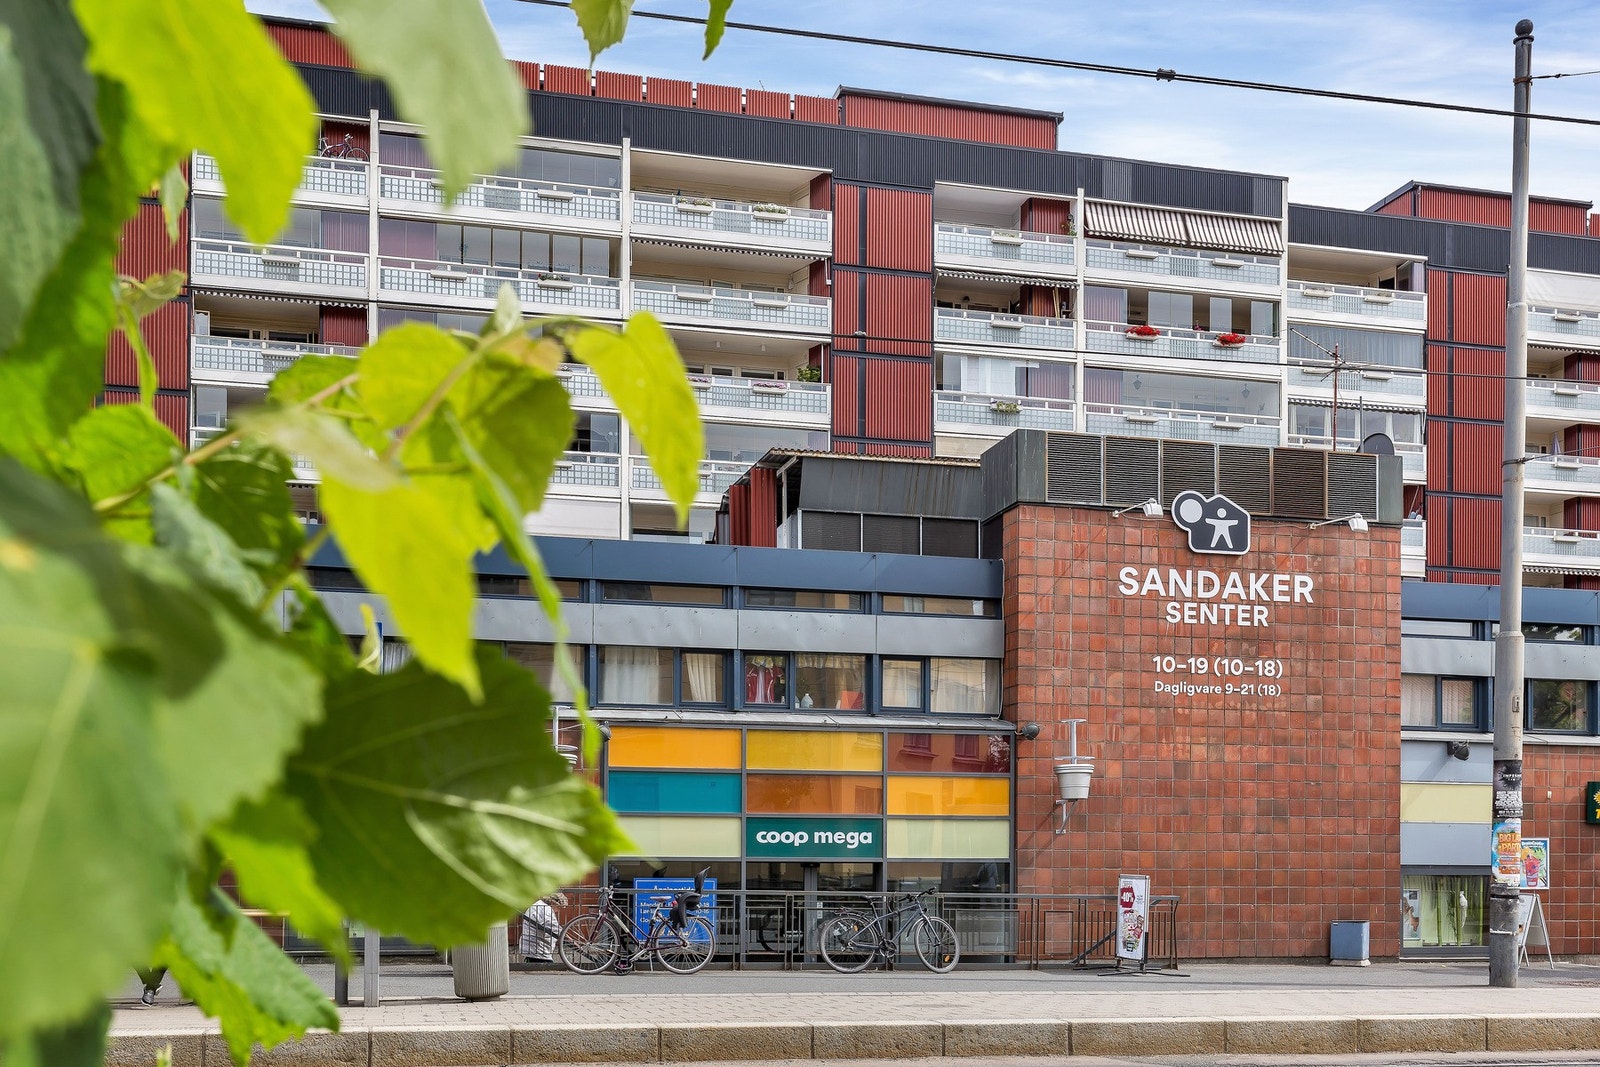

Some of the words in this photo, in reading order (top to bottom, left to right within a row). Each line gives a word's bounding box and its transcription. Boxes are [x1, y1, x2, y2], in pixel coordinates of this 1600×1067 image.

[1118, 566, 1314, 604] SANDAKER
[1165, 601, 1269, 627] SENTER
[1154, 680, 1222, 696] Dagligvare
[1257, 683, 1282, 697] (18)
[756, 830, 809, 847] coop
[813, 831, 873, 849] mega
